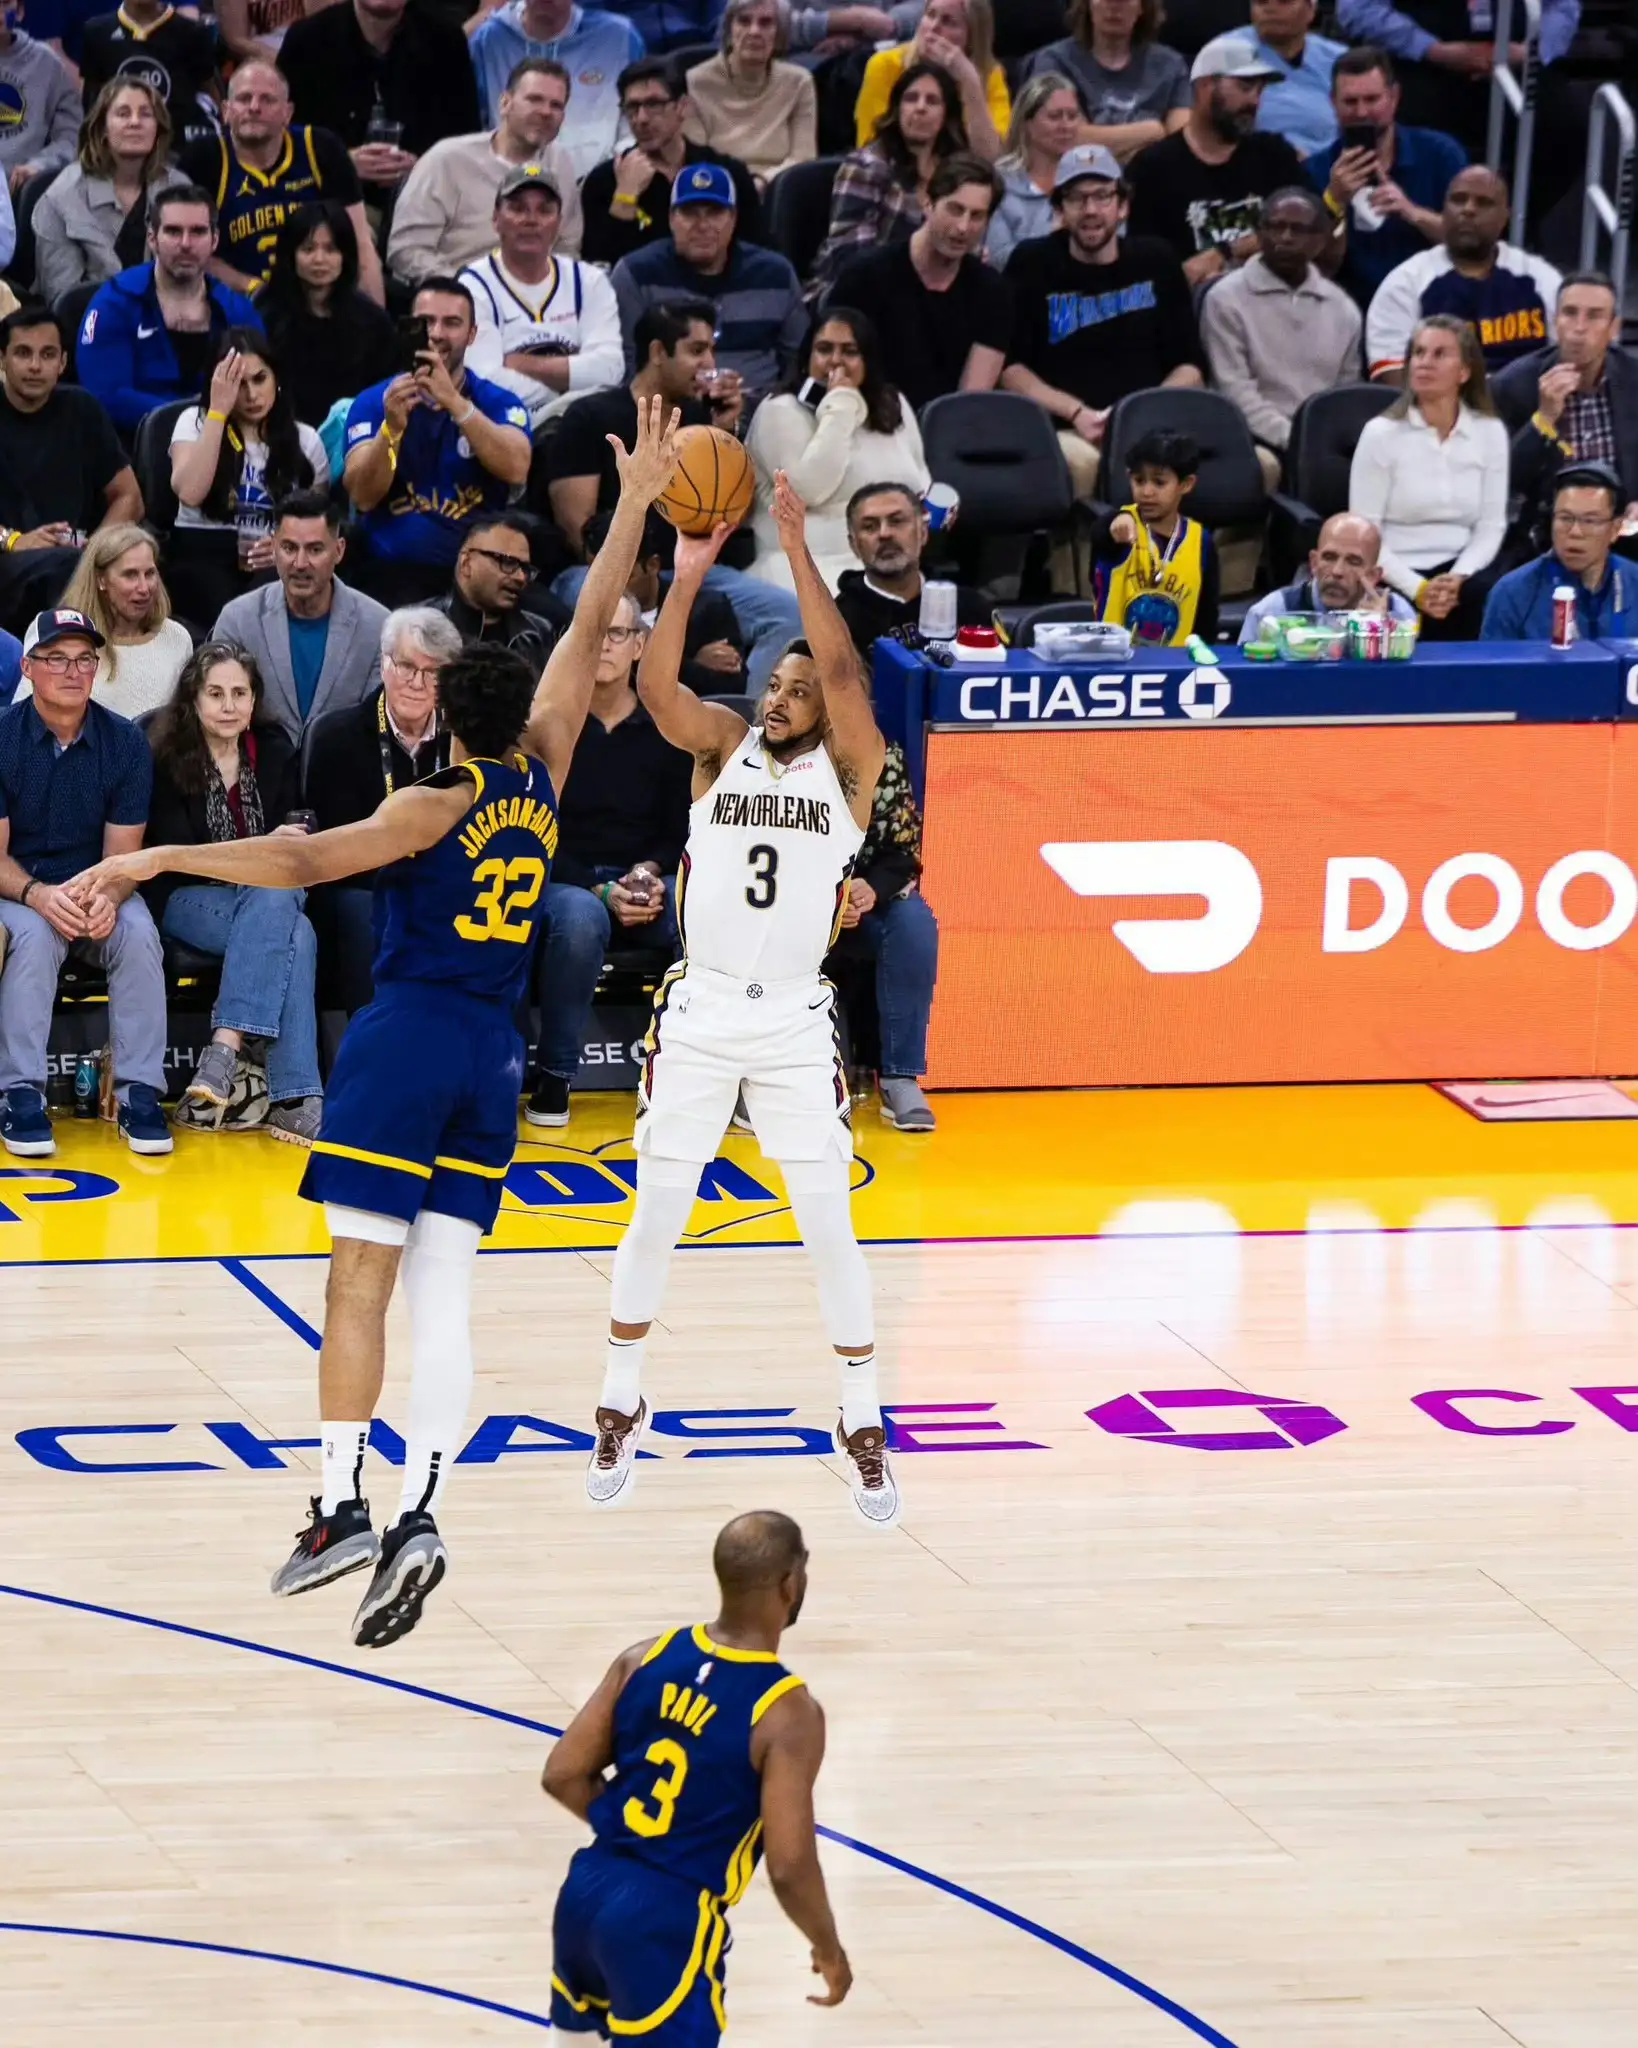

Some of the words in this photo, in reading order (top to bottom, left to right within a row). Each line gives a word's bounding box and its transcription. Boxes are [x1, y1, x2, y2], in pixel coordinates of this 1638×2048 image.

[229, 203, 285, 243] GOLDEN
[960, 674, 1168, 720] CHASE
[453, 856, 546, 944] 32
[744, 843, 779, 909] 3
[14, 1402, 1053, 1474] CHASE
[660, 1682, 719, 1737] PAUL
[623, 1738, 689, 1838] 3
